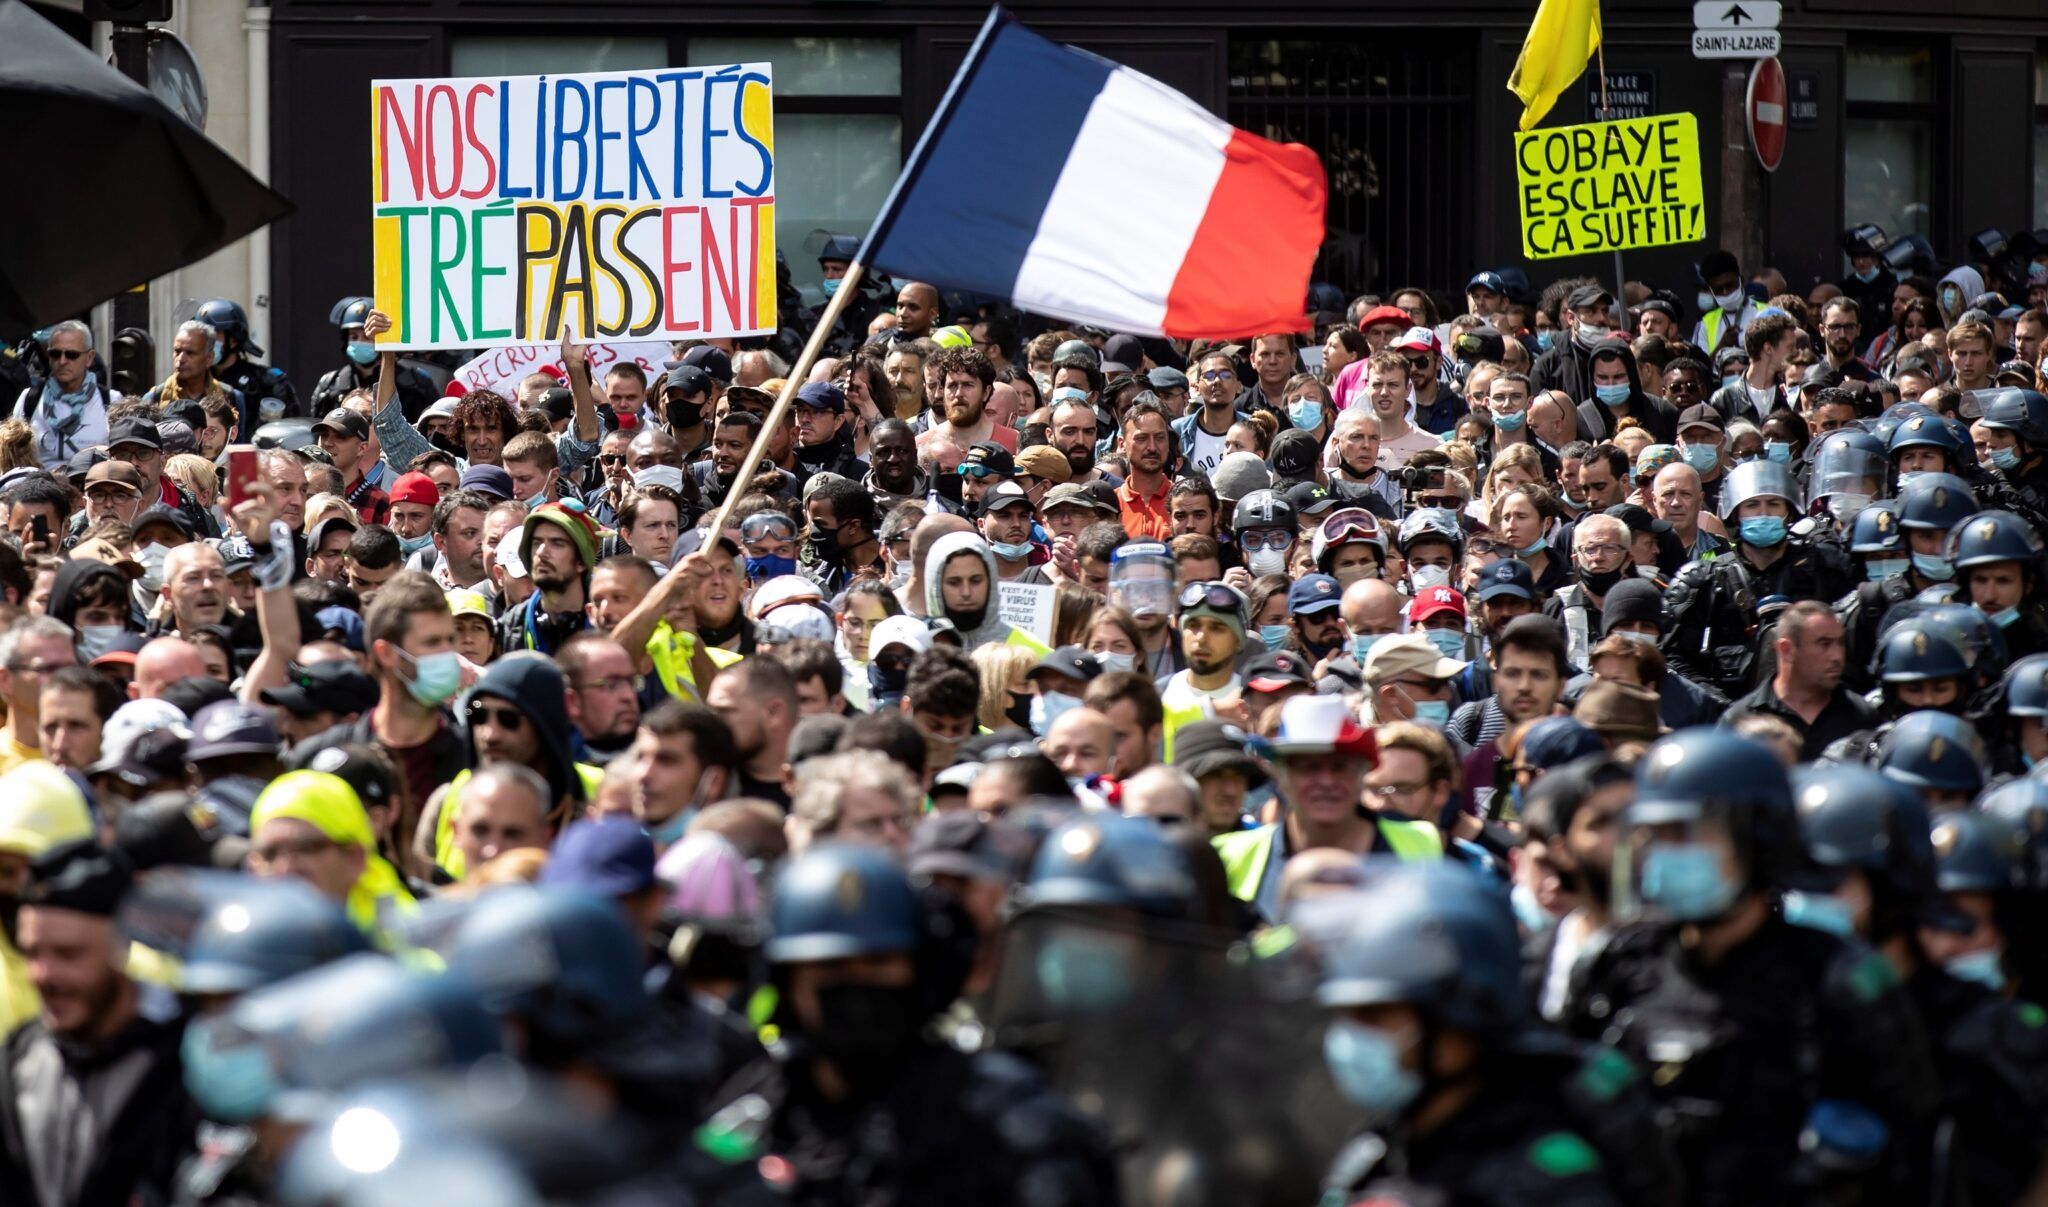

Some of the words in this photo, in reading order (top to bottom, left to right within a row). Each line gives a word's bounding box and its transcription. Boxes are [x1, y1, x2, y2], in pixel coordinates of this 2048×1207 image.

[1695, 36, 1776, 51] SAINT-LAZARE
[380, 83, 496, 201] NOS
[1518, 119, 1680, 177] COBAYE
[1524, 167, 1680, 218] ESCLAVE
[377, 196, 774, 344] TRÉPASSENT
[1007, 595, 1037, 607] VIRUS
